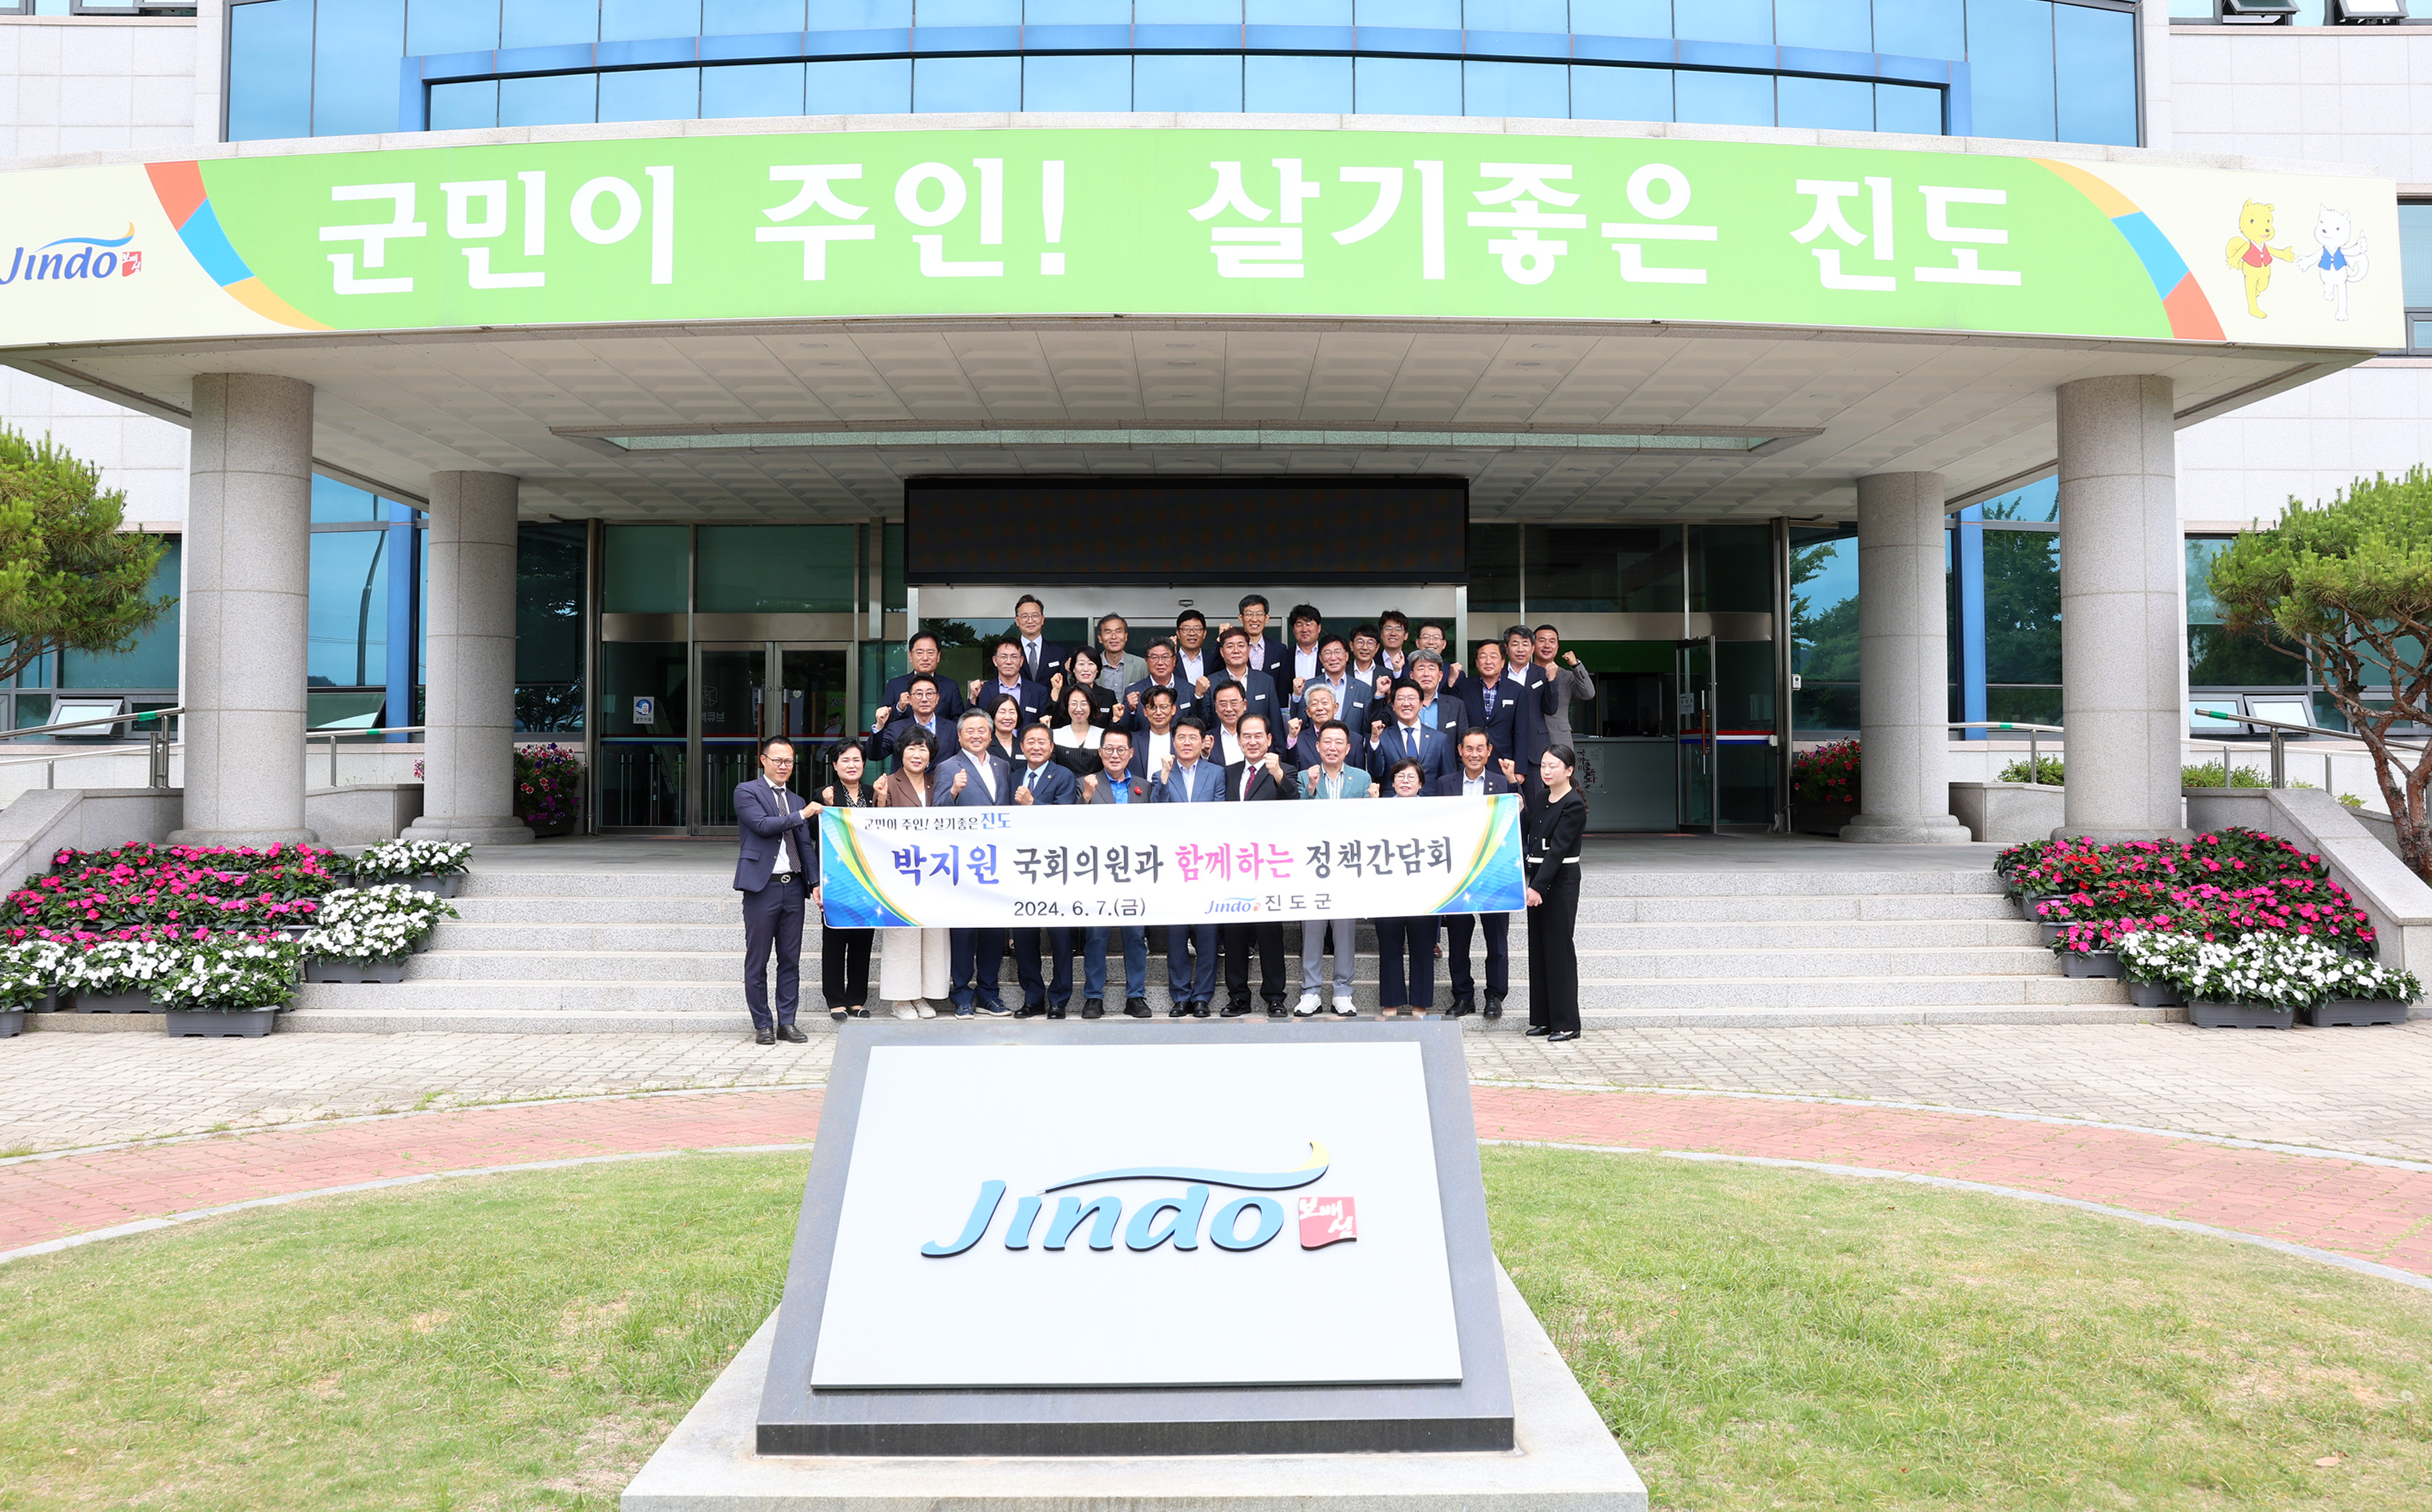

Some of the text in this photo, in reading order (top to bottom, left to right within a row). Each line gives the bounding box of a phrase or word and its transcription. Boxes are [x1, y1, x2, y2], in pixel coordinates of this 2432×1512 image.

[319, 157, 2022, 295] 군민이 주인! 살기좋은 진도
[0, 246, 118, 285] Jindo
[864, 818, 897, 831] 군민이
[902, 817, 929, 831] 주인!
[891, 836, 1453, 887] 박지원 국회의원과 함께하는 정책간담회
[1013, 901, 1065, 917] 2024.
[1205, 900, 1251, 914] Jindo
[920, 1179, 1286, 1258] Jindo
